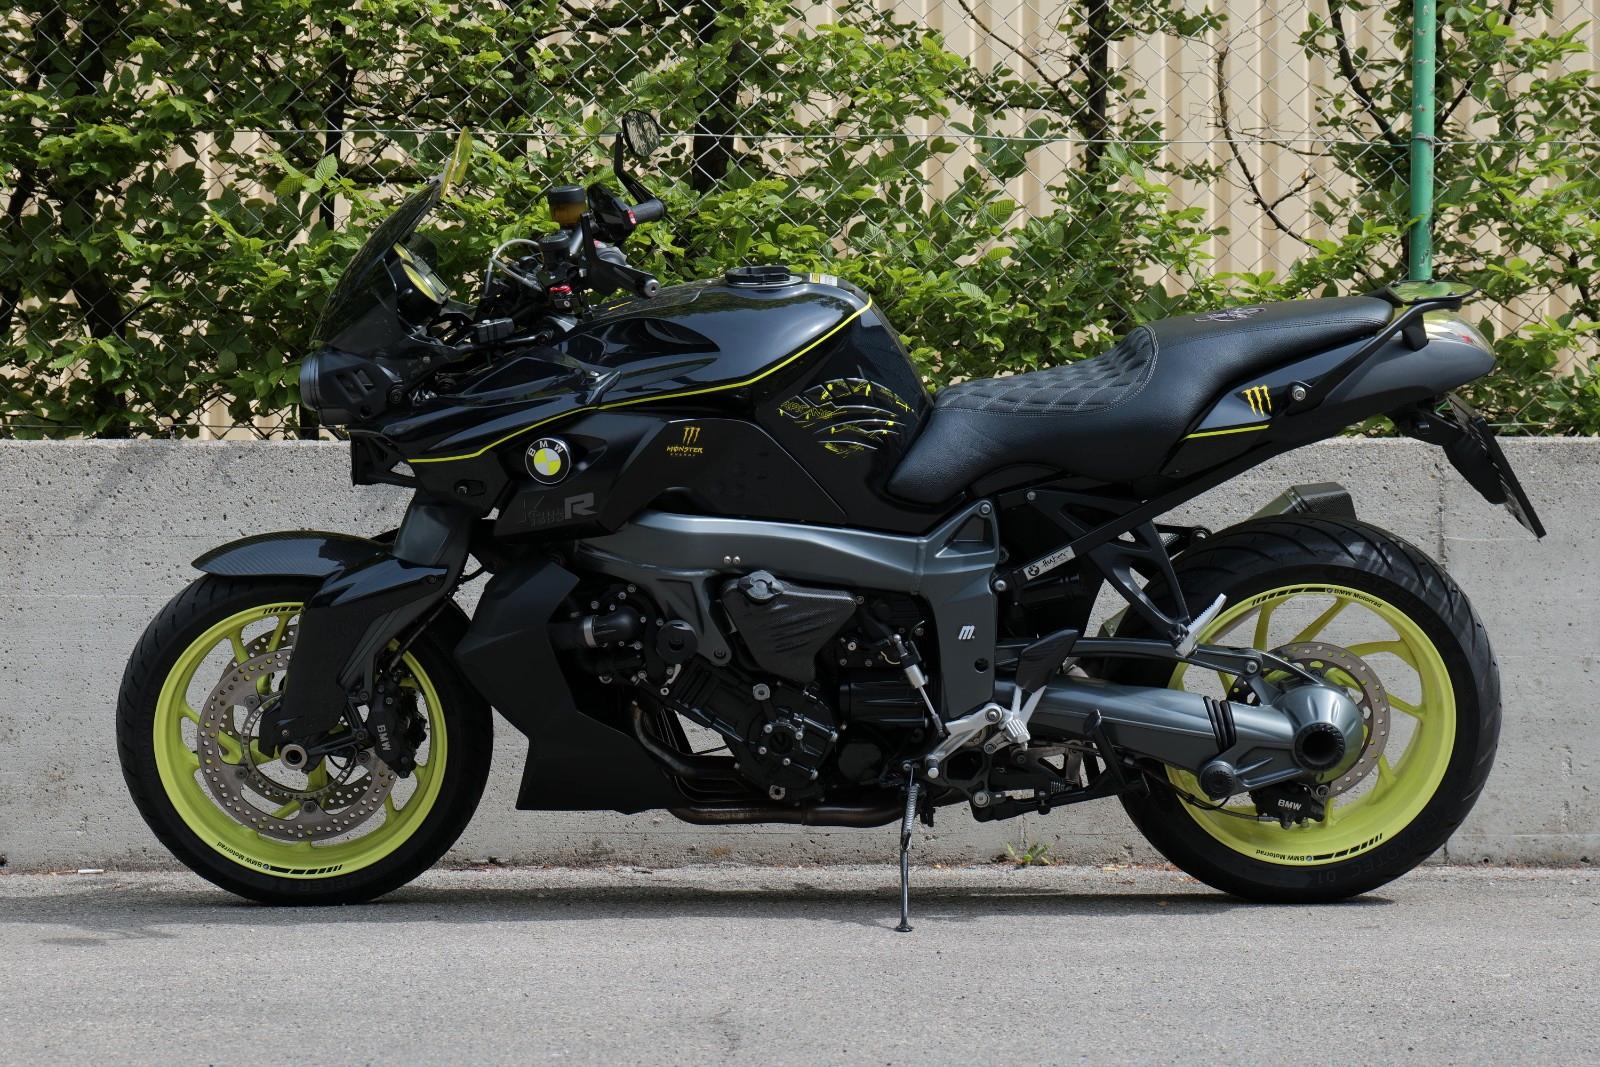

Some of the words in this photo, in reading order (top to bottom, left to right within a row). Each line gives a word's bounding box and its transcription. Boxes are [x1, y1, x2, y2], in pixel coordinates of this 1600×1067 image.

[666, 445, 704, 454] MONSTER
[1334, 588, 1352, 597] BMW
[1352, 592, 1382, 608] Motorrad
[376, 725, 392, 751] BMW
[1277, 799, 1302, 811] BMW
[216, 841, 245, 862] Motorrad
[1255, 849, 1286, 862] Motorrad
[245, 857, 262, 868] BMW
